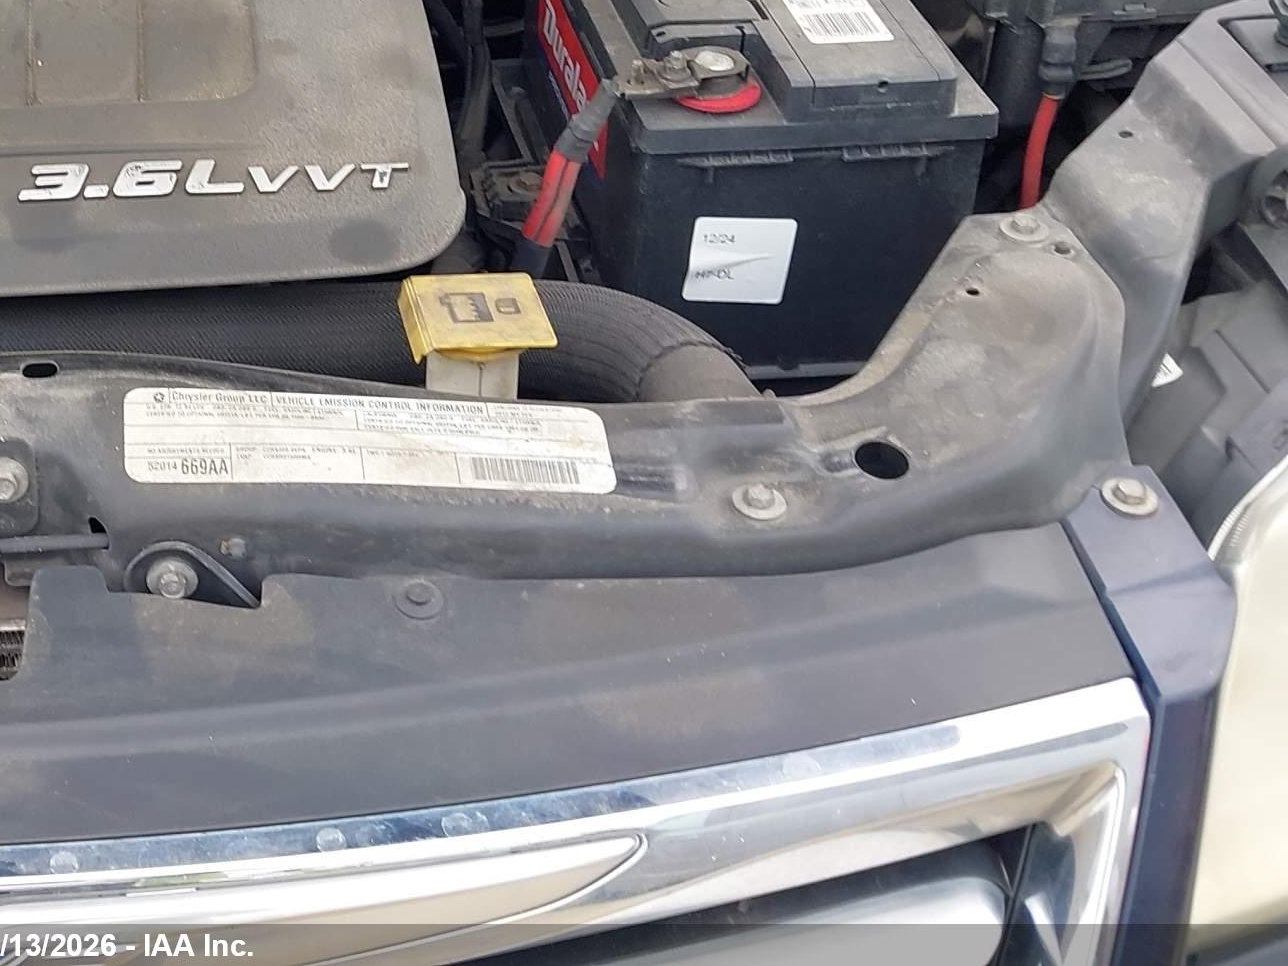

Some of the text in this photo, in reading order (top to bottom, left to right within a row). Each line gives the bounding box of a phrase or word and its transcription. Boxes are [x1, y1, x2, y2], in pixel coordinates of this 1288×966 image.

[172, 390, 268, 404] Chrysler Group LLC
[275, 395, 315, 406] VEHICLE
[319, 396, 365, 409] EMISSION
[368, 400, 411, 412] CONTROL
[415, 402, 484, 414] INFORMATION
[181, 458, 229, 475] 669AA
